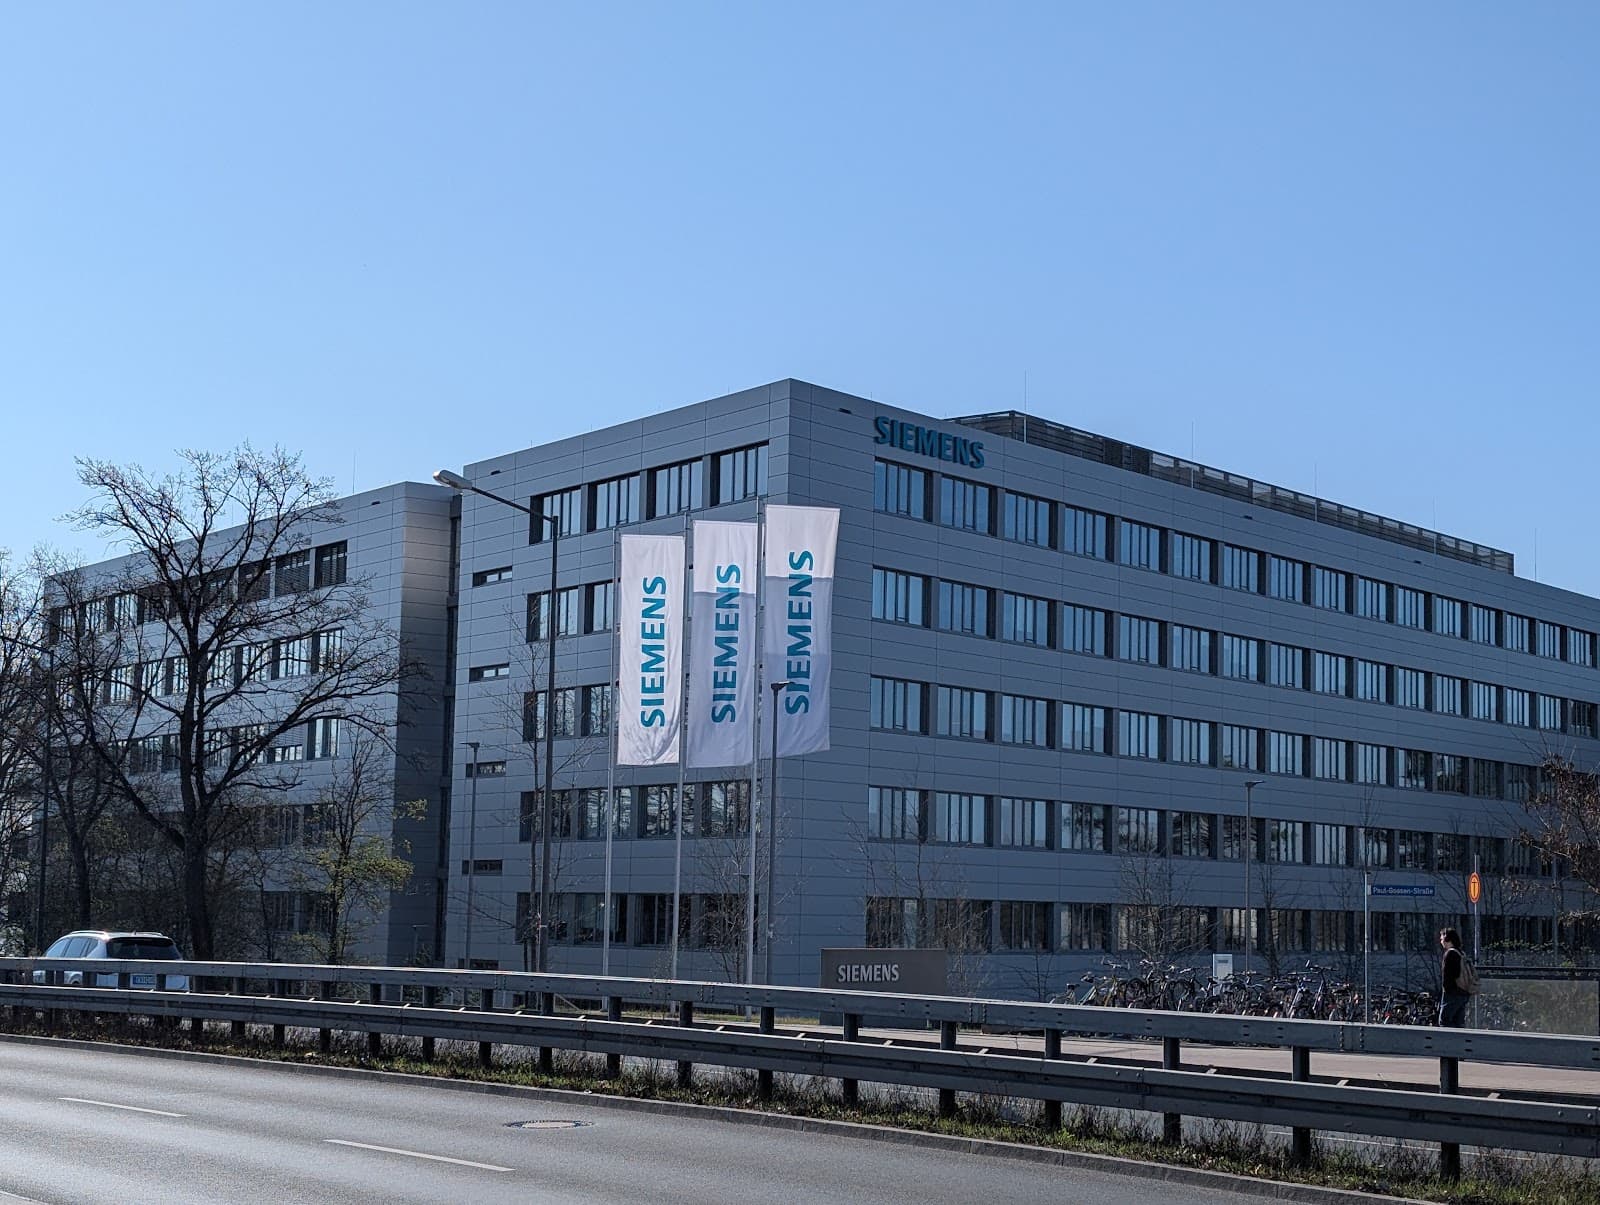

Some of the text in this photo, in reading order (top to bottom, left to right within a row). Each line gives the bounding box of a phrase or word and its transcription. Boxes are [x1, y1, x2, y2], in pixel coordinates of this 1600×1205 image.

[873, 416, 985, 469] SIEMENS
[641, 576, 667, 728] SIEMENS
[712, 563, 741, 724] SIEMENS
[785, 550, 814, 715] SIEMENS
[837, 964, 900, 983] SIEMENS
